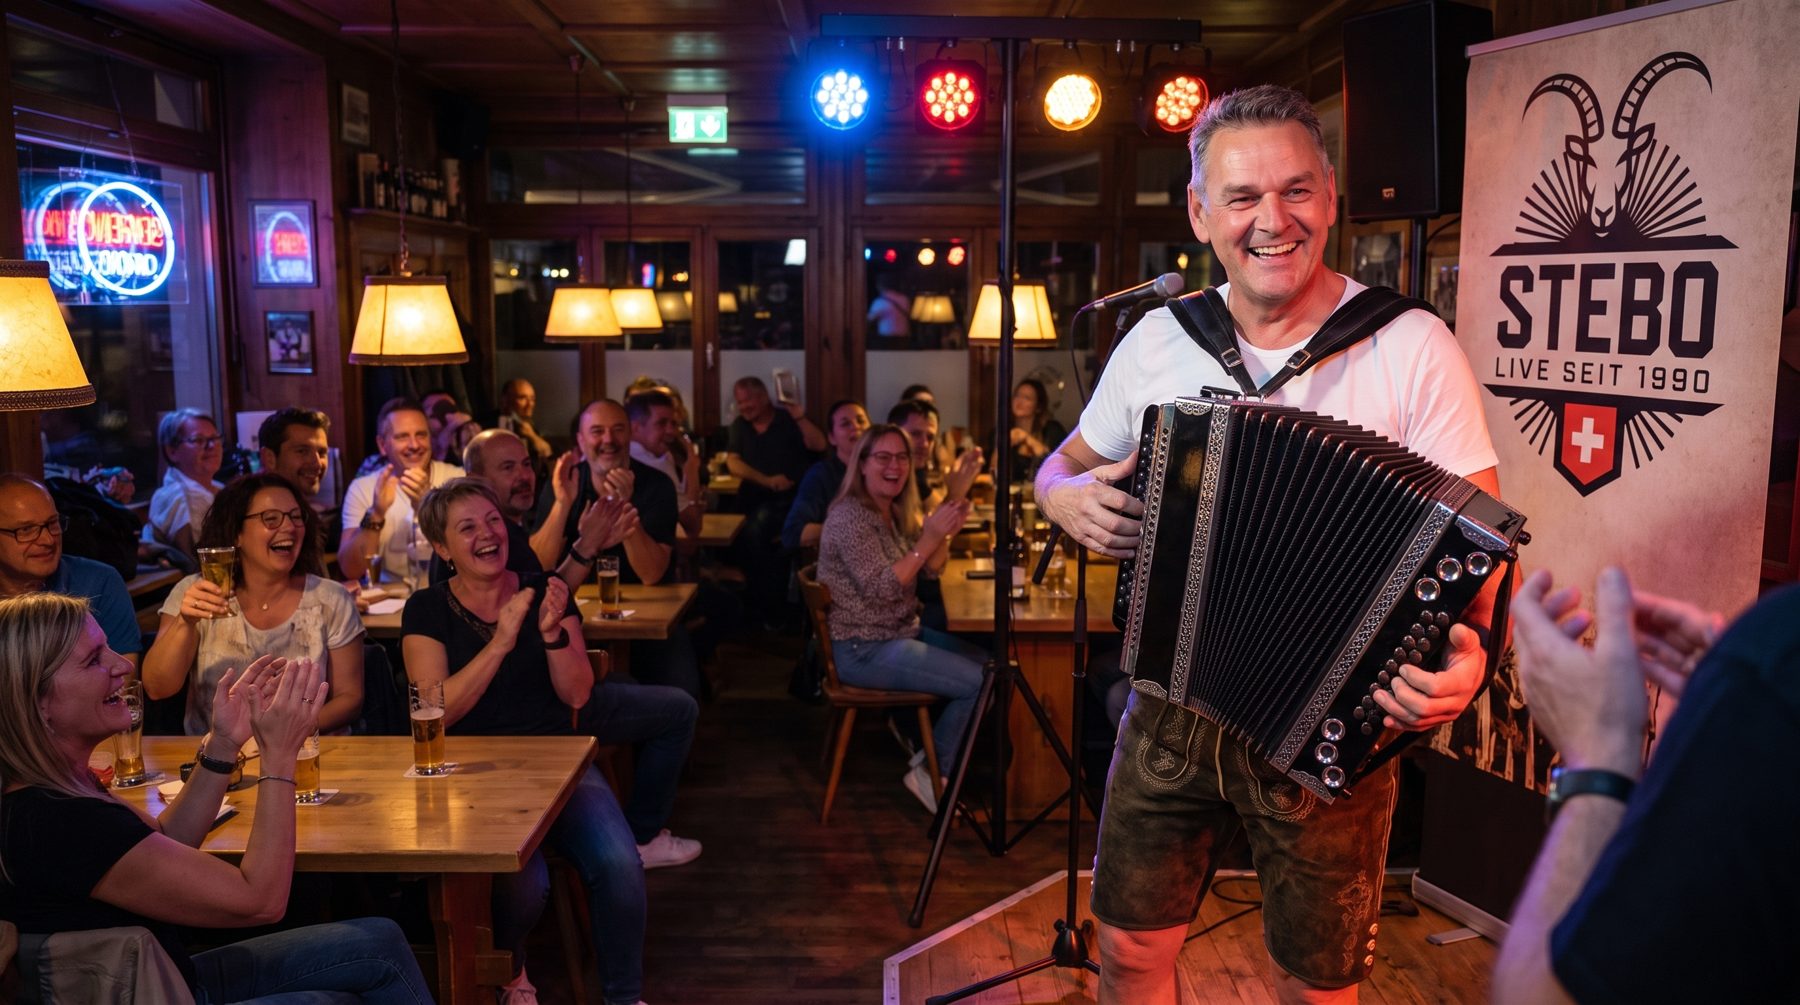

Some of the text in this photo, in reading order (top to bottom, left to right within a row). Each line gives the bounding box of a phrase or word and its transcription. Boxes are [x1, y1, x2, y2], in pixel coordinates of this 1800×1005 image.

[1497, 261, 1719, 359] STEBO
[1495, 357, 1710, 394] LIVE SEIT 1990
